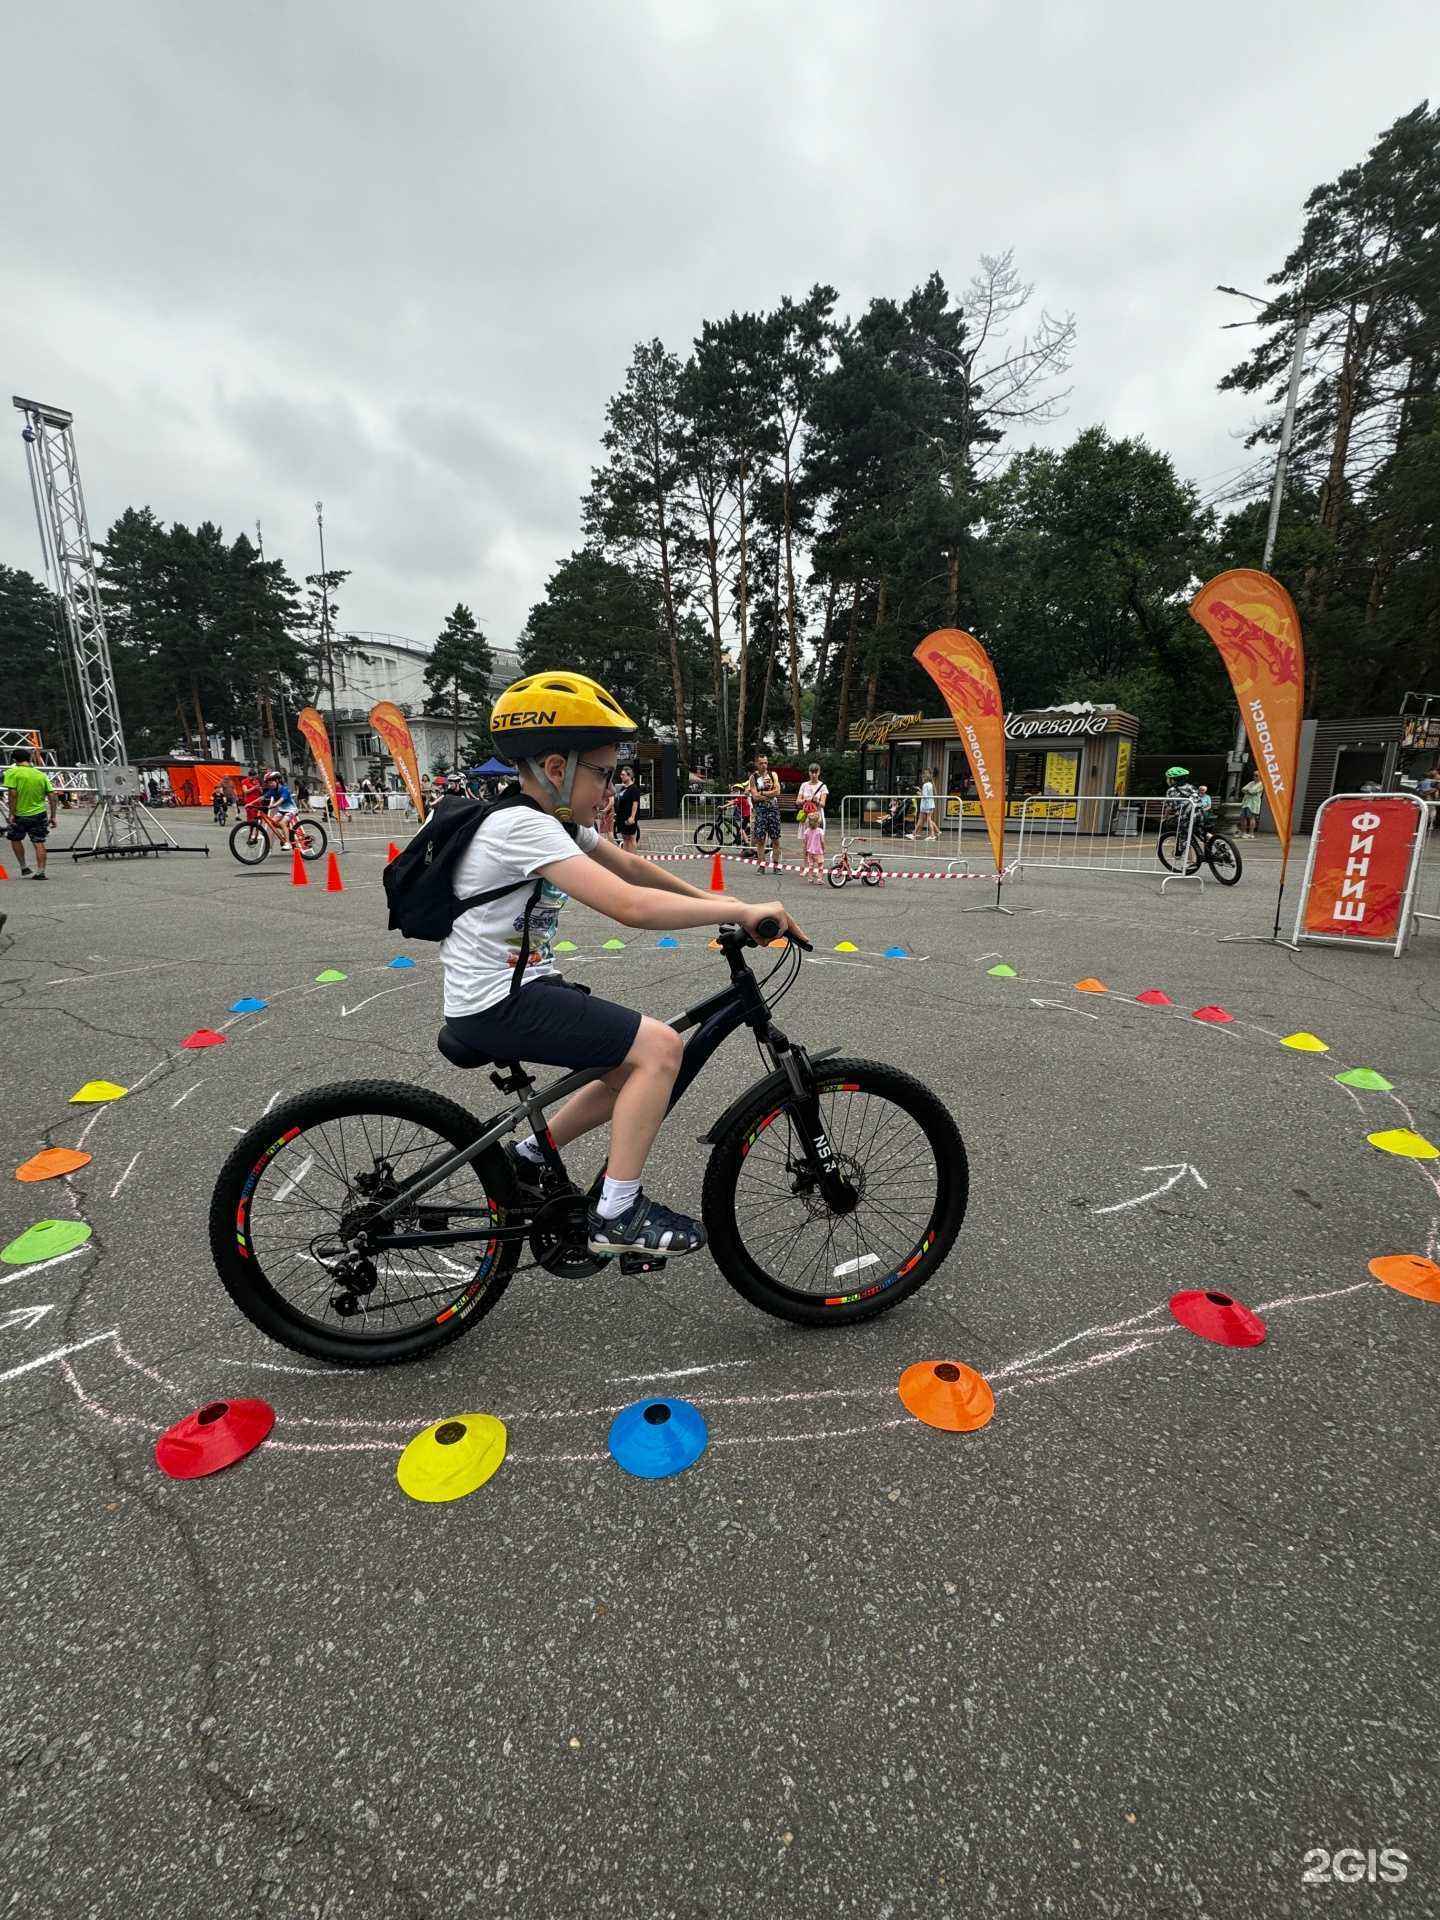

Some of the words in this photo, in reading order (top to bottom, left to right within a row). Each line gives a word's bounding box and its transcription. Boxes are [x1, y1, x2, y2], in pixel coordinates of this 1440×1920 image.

[492, 711, 557, 730] STERN
[1003, 711, 1109, 740] Кофеварка
[1332, 811, 1381, 922] ФИНИШ
